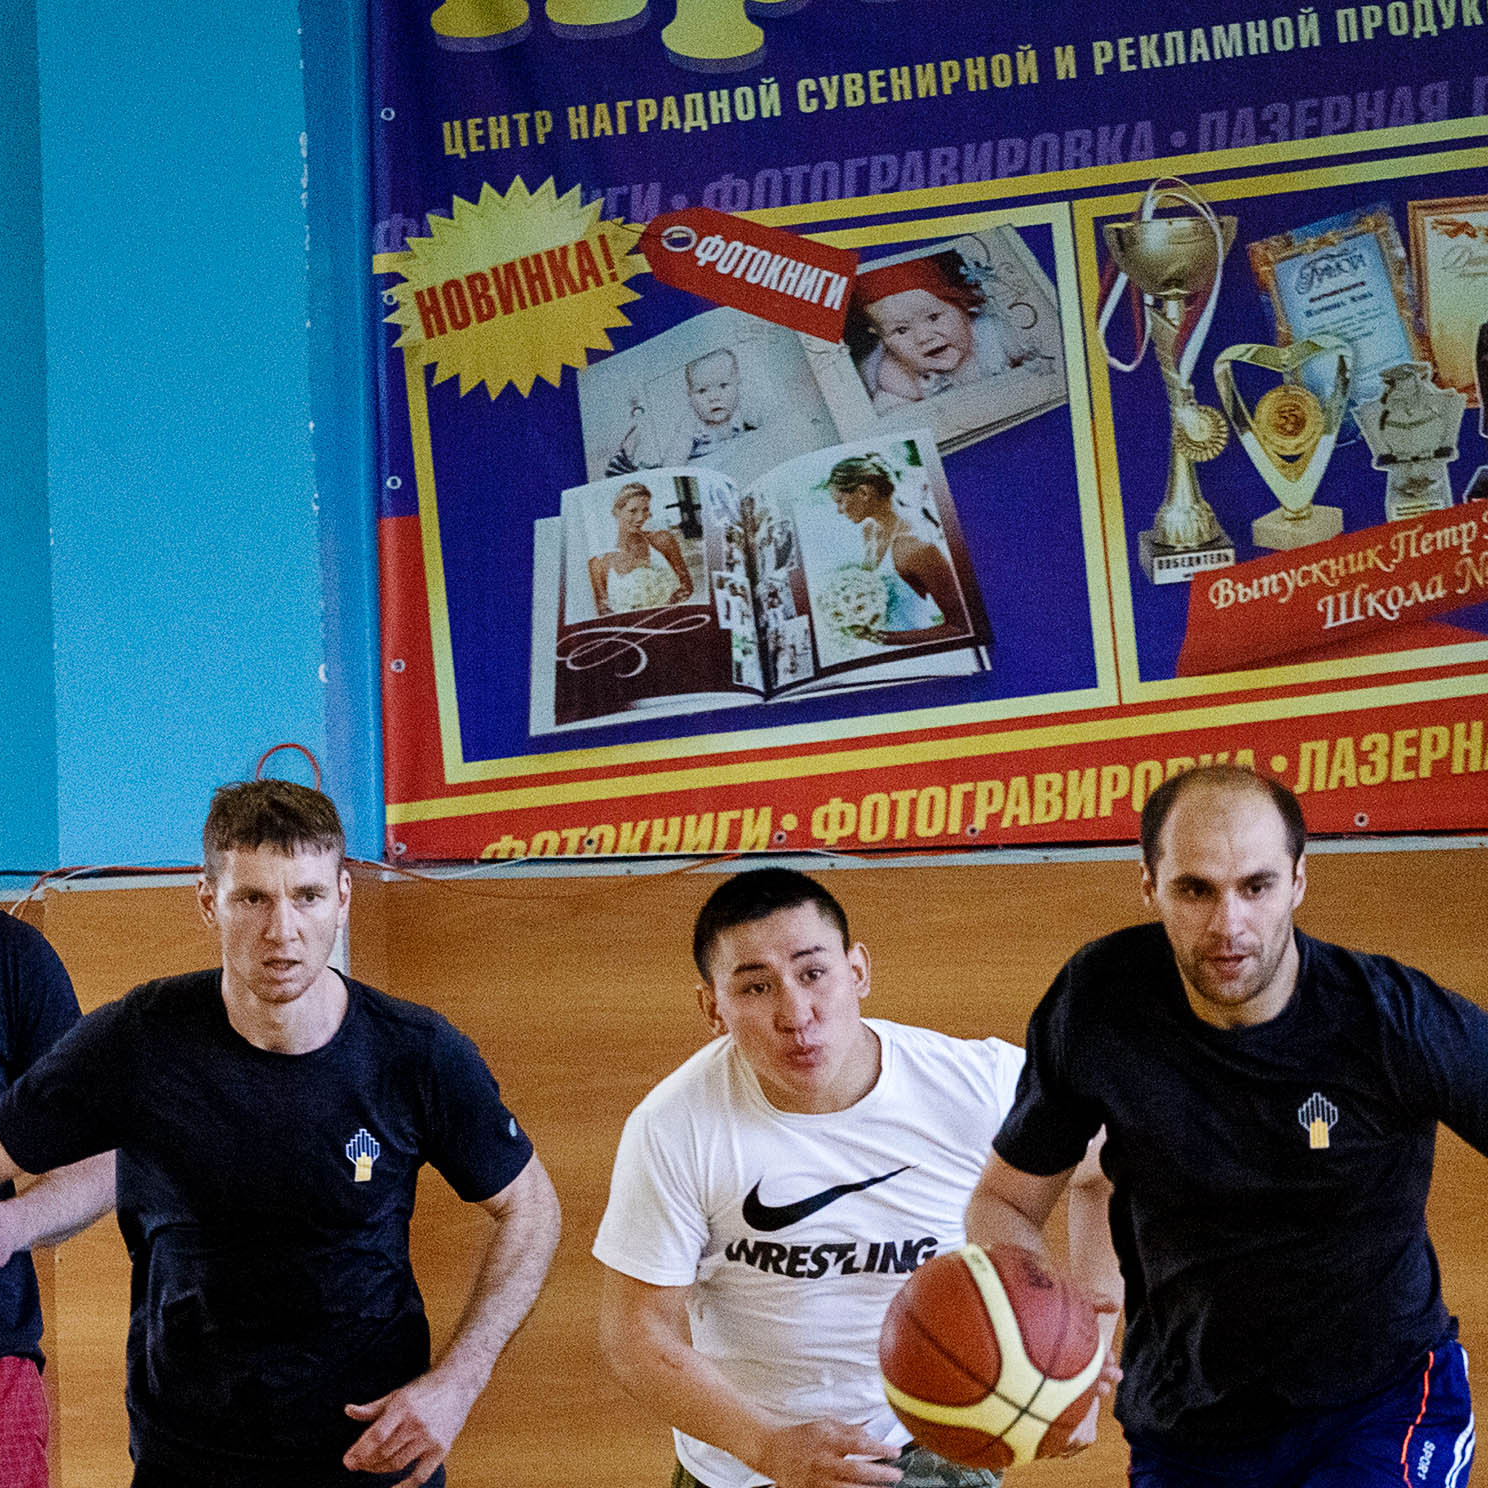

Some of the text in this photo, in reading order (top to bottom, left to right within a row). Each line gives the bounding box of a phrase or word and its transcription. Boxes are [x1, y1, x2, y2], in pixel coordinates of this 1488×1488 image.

[443, 109, 555, 159] ЦЕНТР
[567, 77, 782, 141] НАГРАДНОЙ
[796, 44, 1039, 114] СУВЕНИРНОЙ
[1054, 45, 1078, 81] И
[1093, 8, 1322, 77] РЕКЛАМНОЙ
[414, 233, 618, 339] НОВИНКА!
[694, 234, 849, 312] ФОТОКНИГИ
[1208, 545, 1394, 609] Выпускник
[1389, 521, 1478, 566] Петр
[1316, 573, 1449, 630] Школа
[809, 749, 1257, 848] ФОТОГРАВИРО
[724, 1236, 939, 1279] WRESTLING
